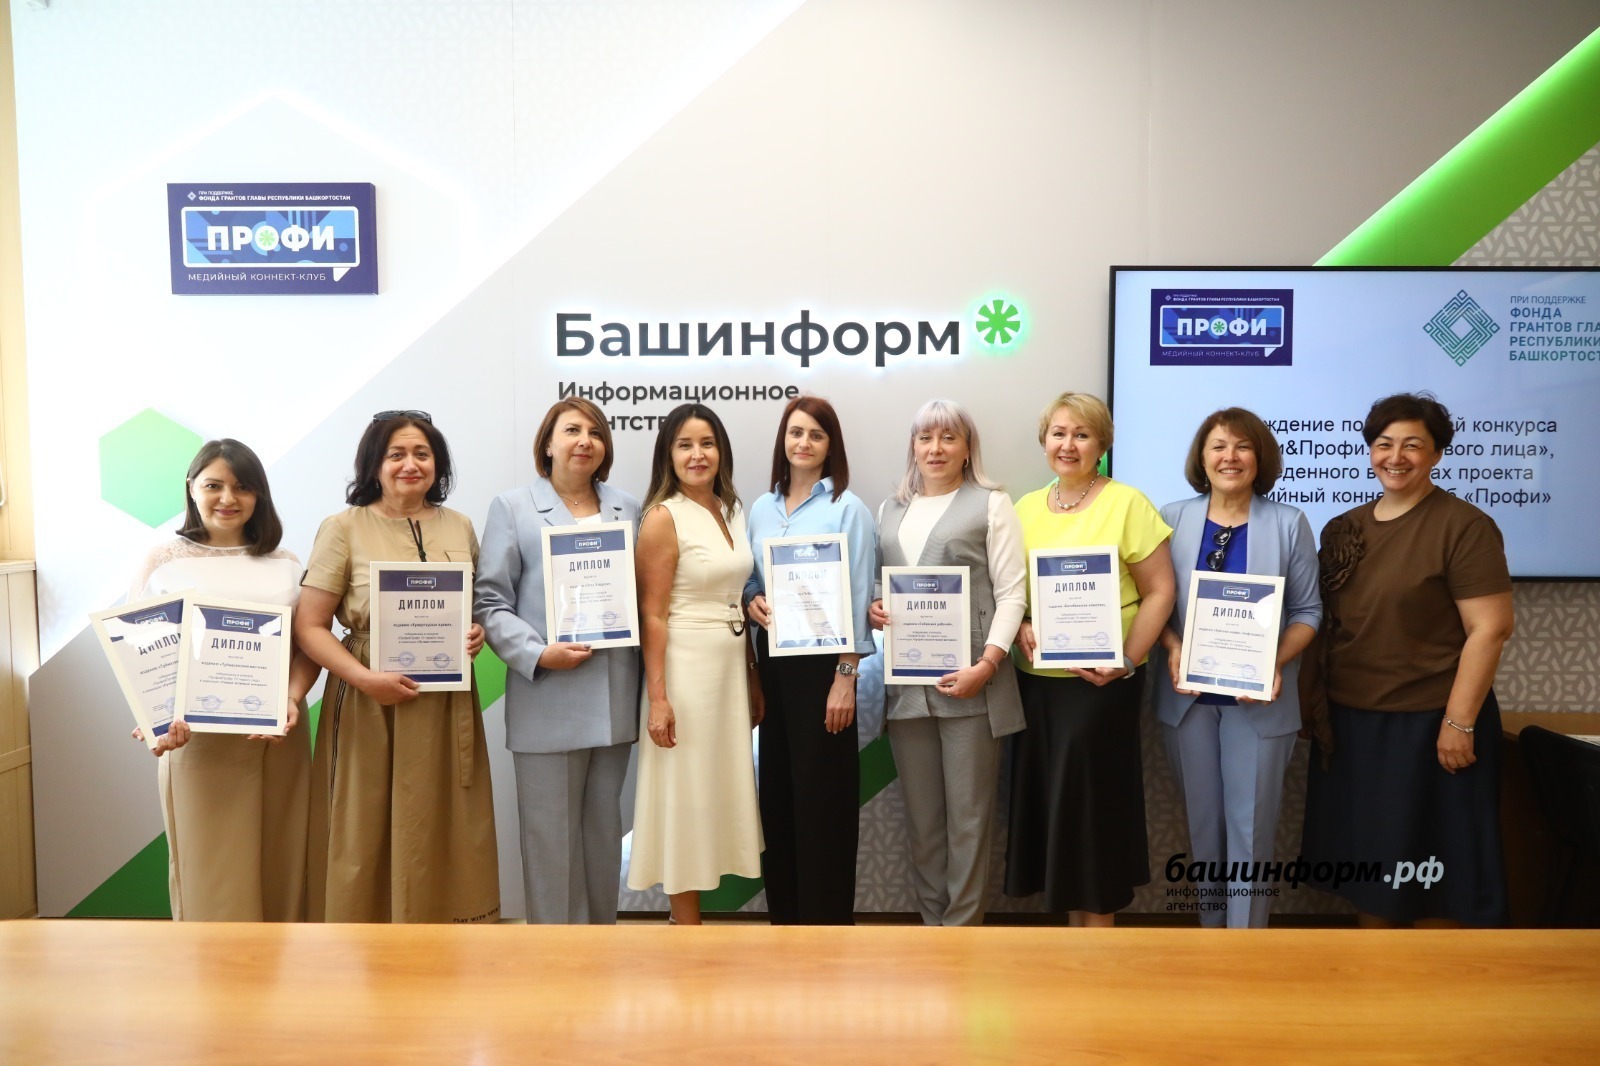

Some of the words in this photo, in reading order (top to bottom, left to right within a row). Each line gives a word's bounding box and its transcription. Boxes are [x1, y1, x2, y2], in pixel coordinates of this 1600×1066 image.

[206, 224, 335, 252] ПРОФИ
[188, 272, 247, 282] МЕДИЙНЫЙ
[249, 272, 326, 282] КОННЕКТ-КЛУБ
[1510, 296, 1529, 304] ПРИ
[1531, 296, 1587, 305] ПОДДЕРЖКЕ
[1510, 307, 1562, 320] ФОНДА
[1177, 318, 1267, 337] ПРОФИ
[1510, 322, 1572, 333] ГРАНТОВ
[1577, 322, 1600, 333] ГЛА
[556, 310, 961, 367] Башинформ
[1509, 336, 1600, 347] РЕСПУБЛИКИ
[1162, 350, 1204, 358] МЕДИЙНЫЙ
[1509, 350, 1600, 361] БАШКОРТОСТ
[558, 381, 799, 405] Информационное
[1264, 420, 1335, 434] ждение
[1473, 420, 1557, 436] конкурса
[1444, 445, 1484, 456] вого
[1491, 445, 1554, 459] лица»,
[1458, 468, 1533, 483] проекта
[1464, 488, 1551, 507] «Профи»
[569, 558, 611, 572] ДИПЛОМ
[1054, 581, 1096, 593] ДИПЛОМ
[398, 599, 445, 611] ДИПЛОМ
[906, 600, 947, 611] ДИПЛОМ
[226, 619, 250, 627] ПРОФИ
[211, 637, 262, 652] ДИПЛОМ
